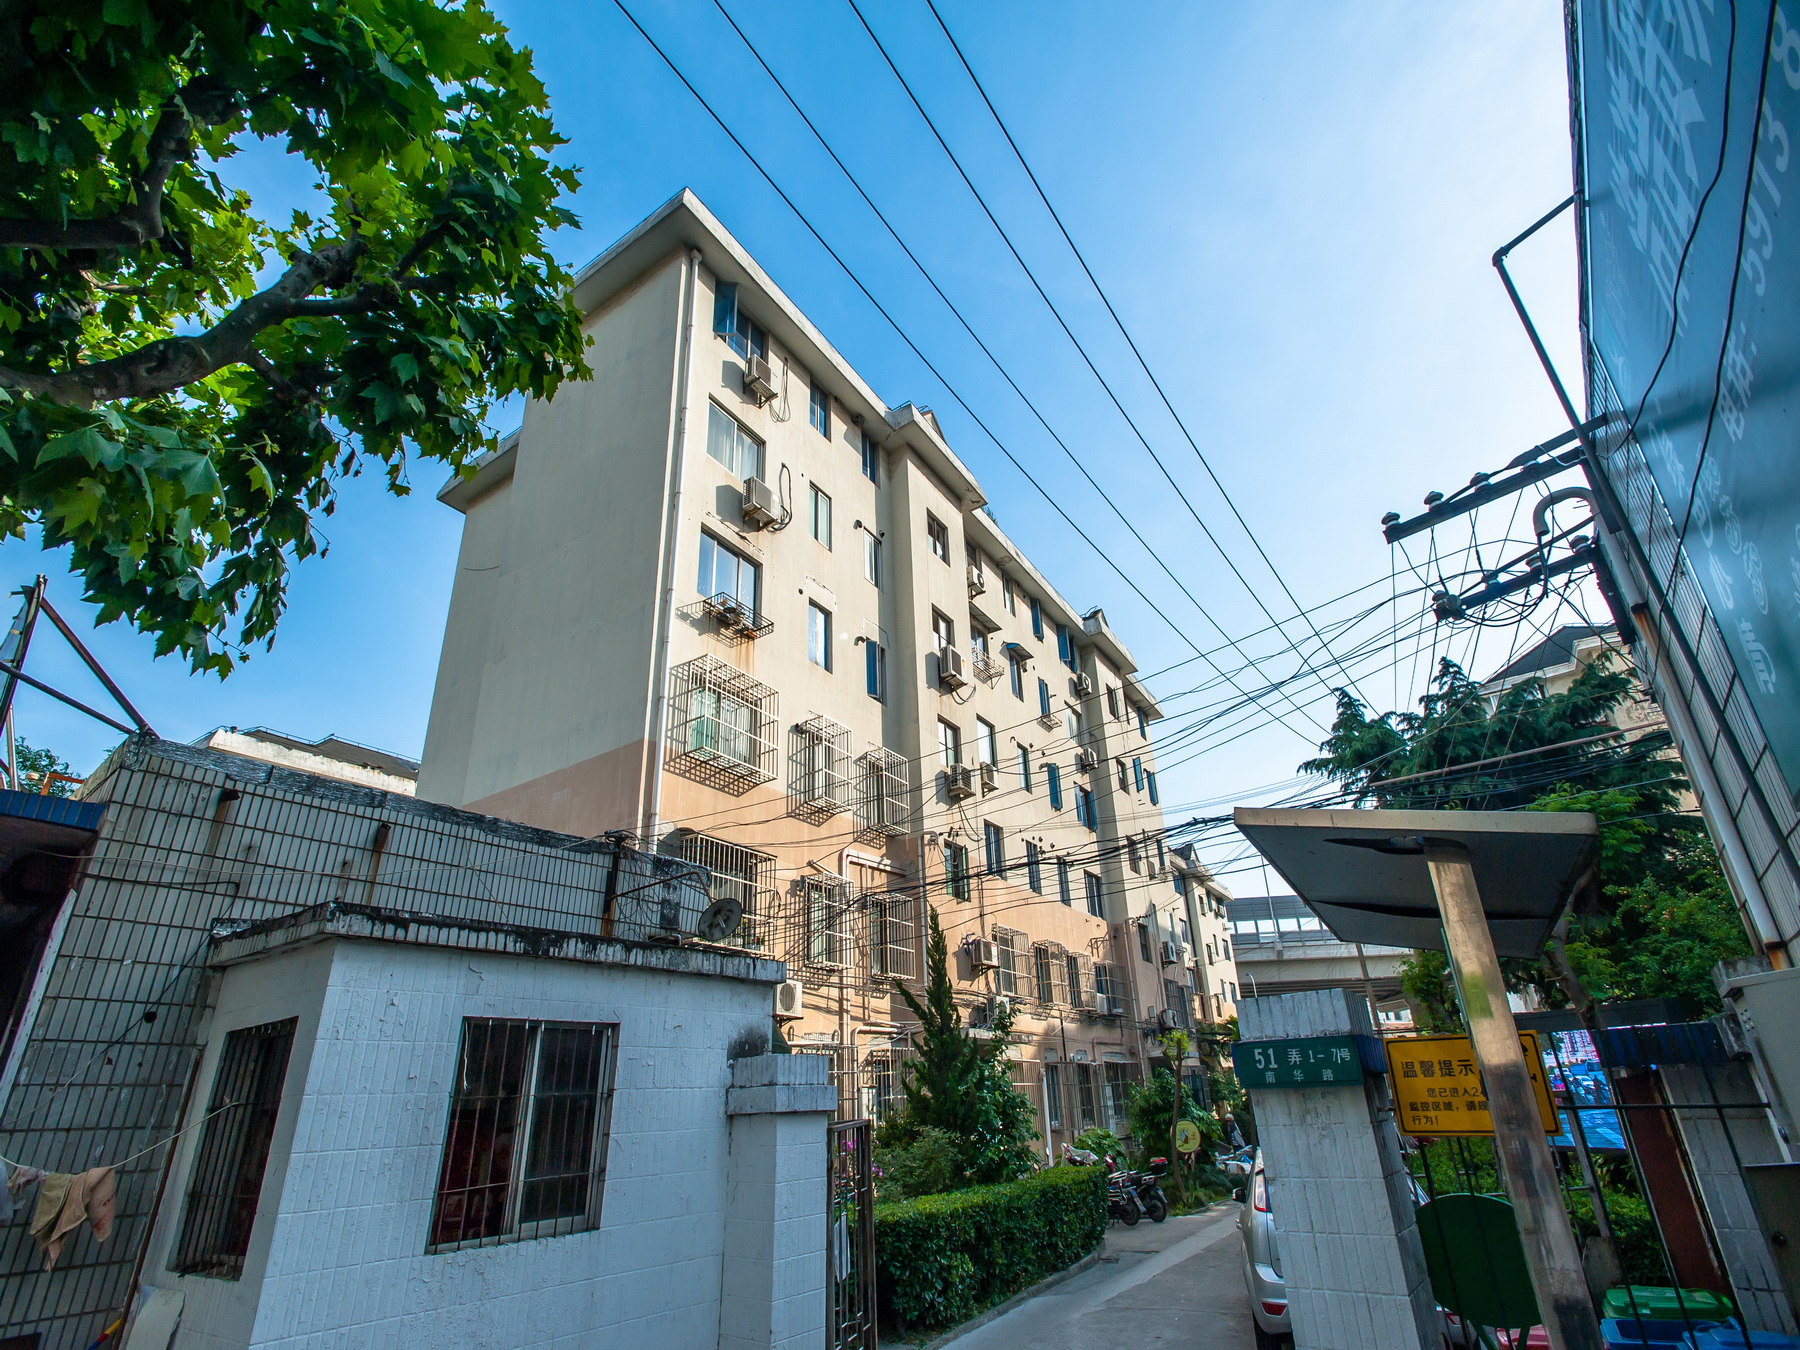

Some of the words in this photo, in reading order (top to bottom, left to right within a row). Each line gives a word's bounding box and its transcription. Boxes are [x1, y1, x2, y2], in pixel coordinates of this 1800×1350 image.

[1401, 1059, 1475, 1078] 温馨提示
[1265, 1069, 1334, 1084] 南华路
[1426, 1086, 1485, 1098] 您已进入2
